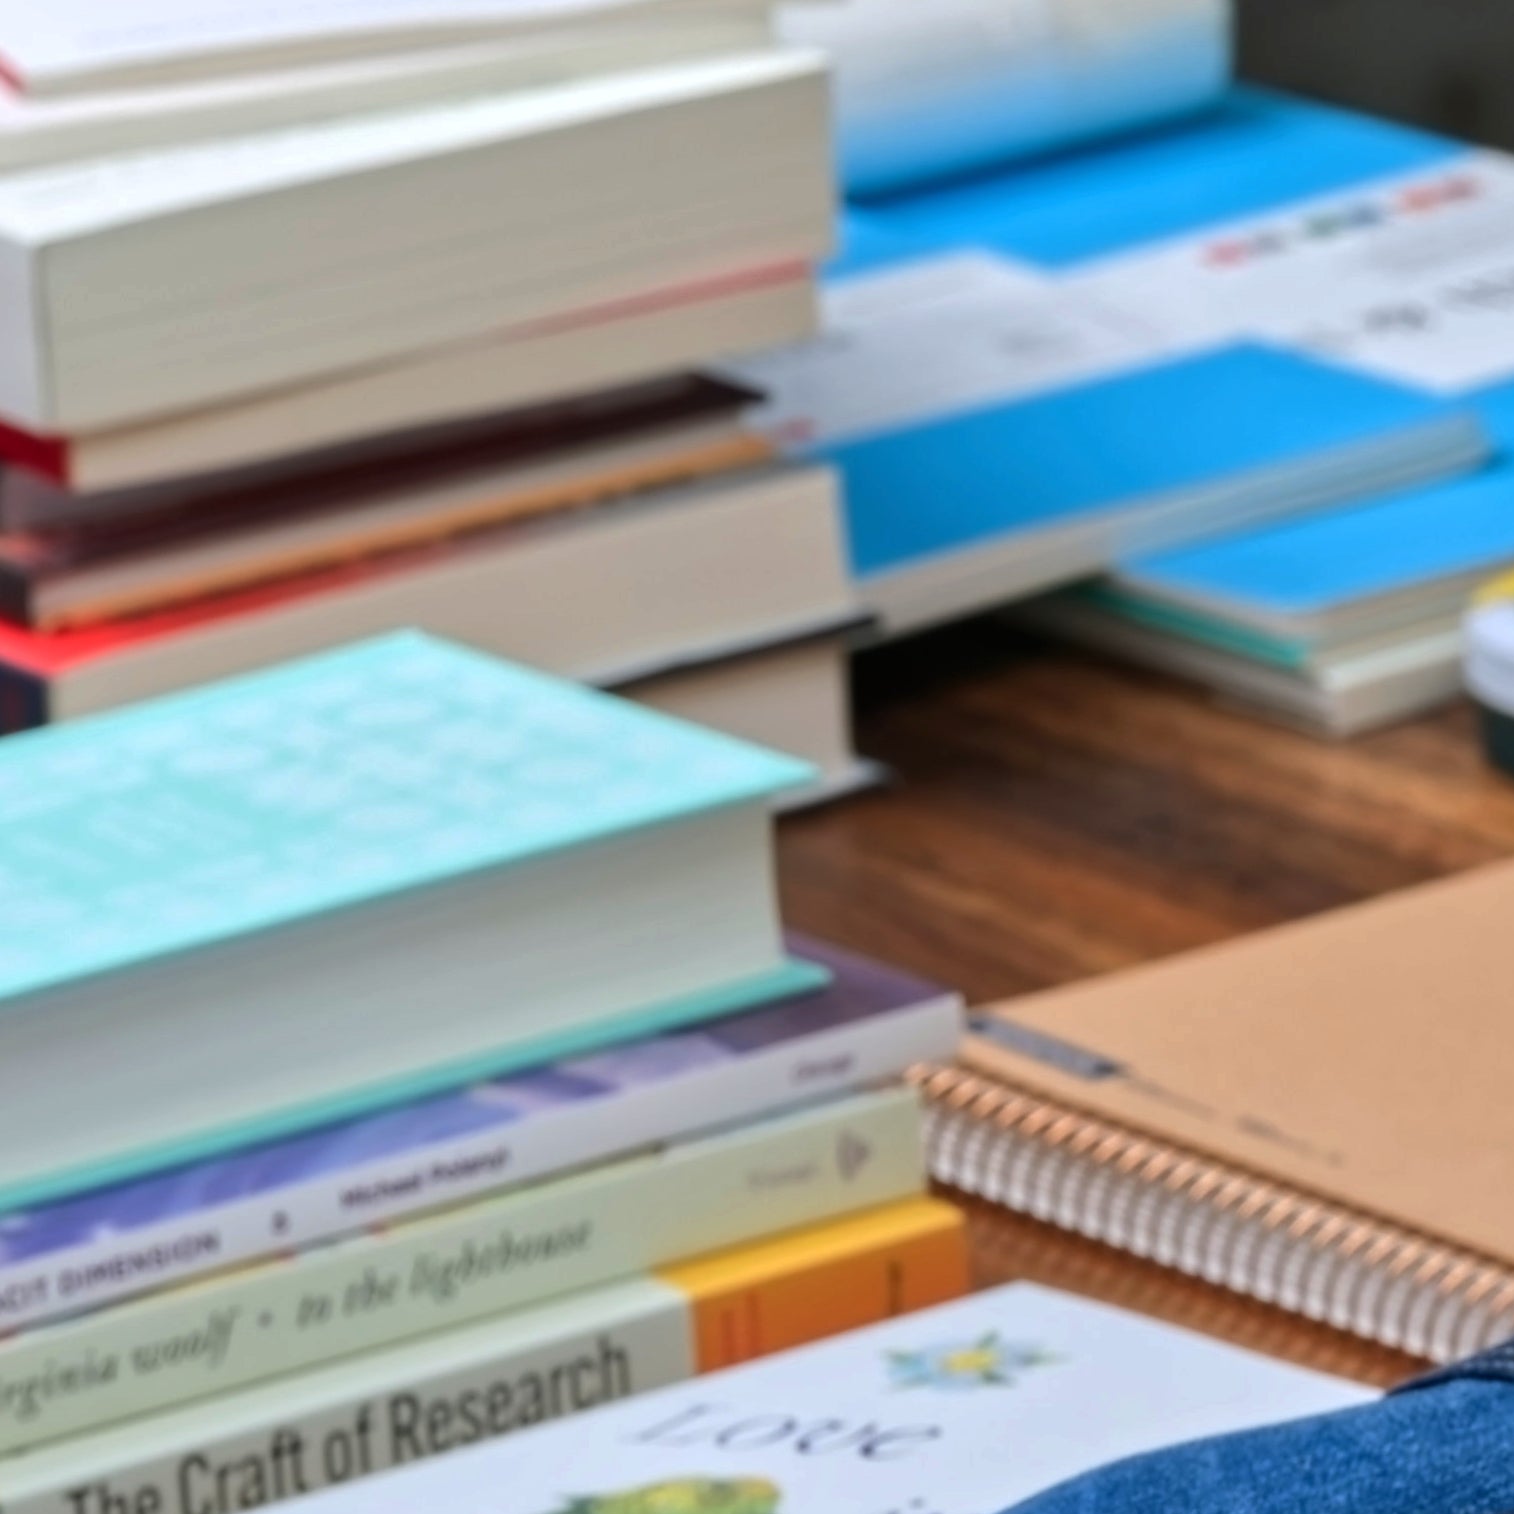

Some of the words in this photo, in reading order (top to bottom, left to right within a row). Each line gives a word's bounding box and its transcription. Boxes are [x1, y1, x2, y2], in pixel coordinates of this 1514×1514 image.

[57, 1230, 221, 1297] DIMENSION
[132, 1304, 242, 1369] woolf
[296, 1288, 333, 1328] to
[342, 1264, 398, 1316] the
[408, 1218, 592, 1306] lighthouse
[322, 1406, 383, 1483] of
[393, 1336, 633, 1466] Research
[618, 1402, 942, 1462] Love
